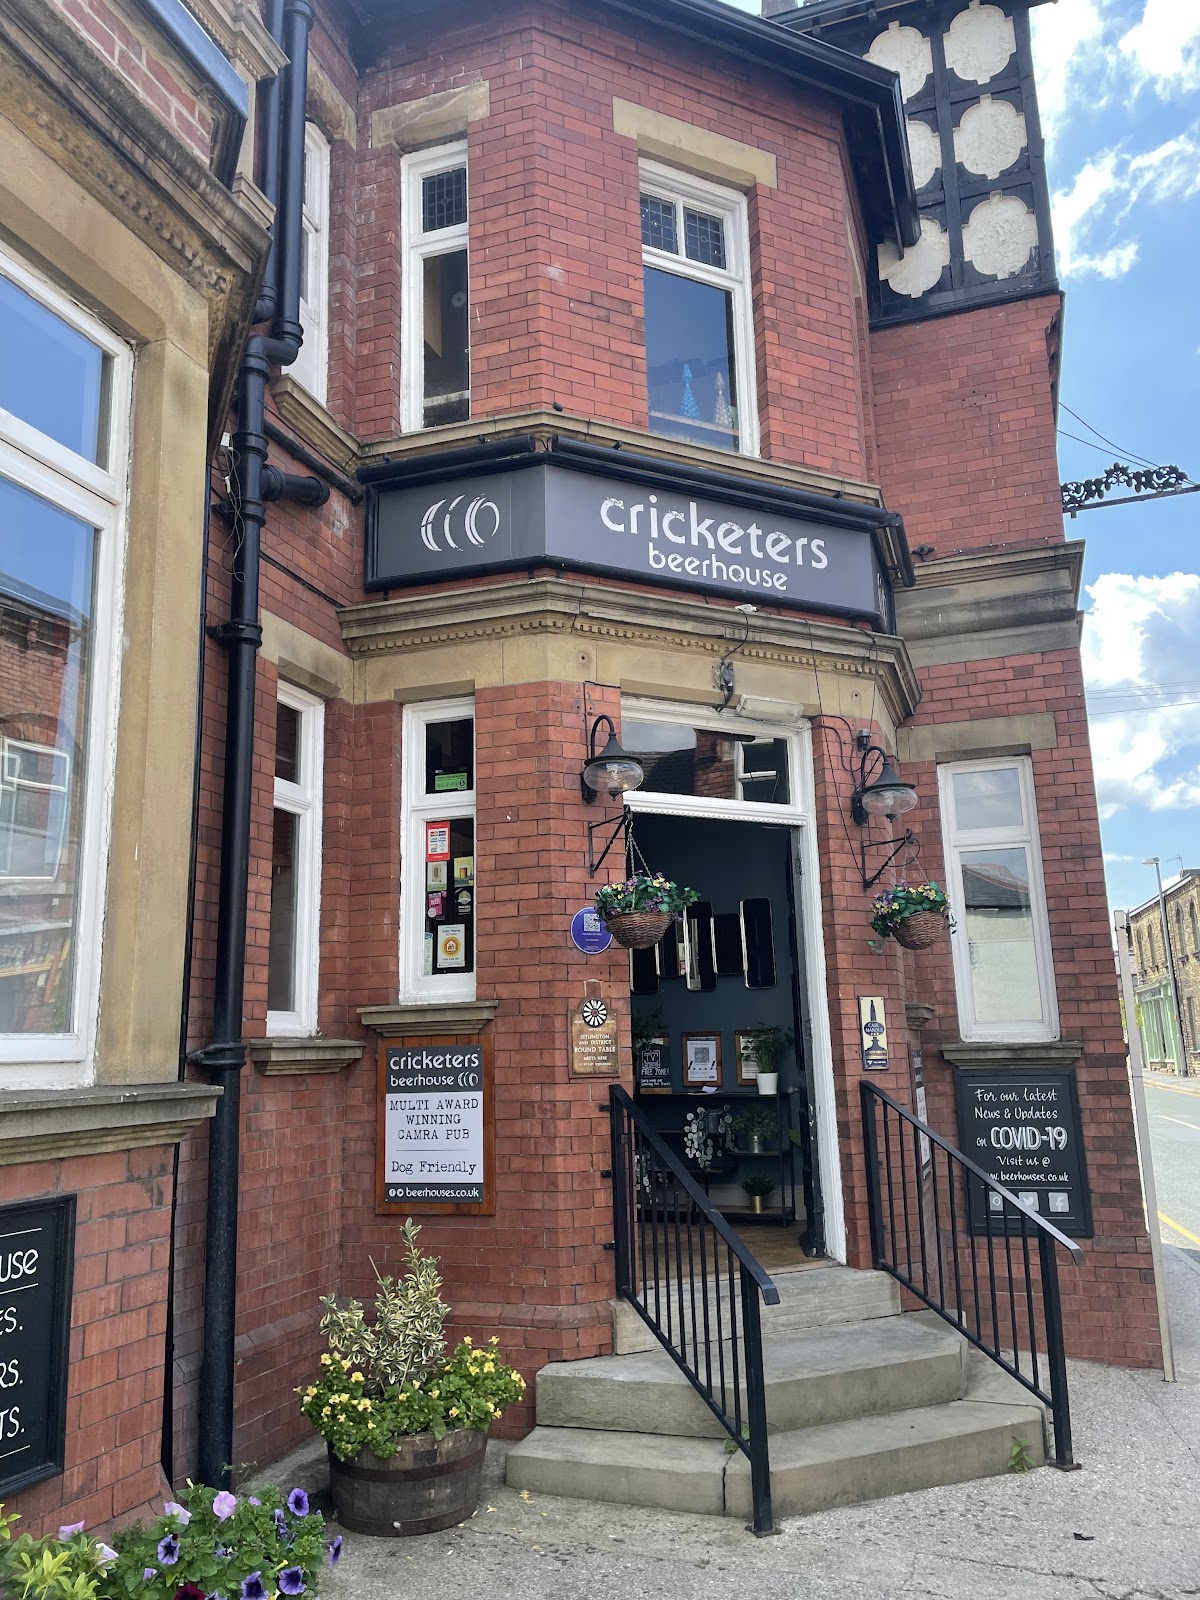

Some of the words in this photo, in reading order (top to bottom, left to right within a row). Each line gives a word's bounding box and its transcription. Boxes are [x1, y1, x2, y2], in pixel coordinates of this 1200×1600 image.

[600, 494, 828, 569] cricketers
[648, 541, 789, 590] beerhouse
[389, 1050, 479, 1070] cricketers
[390, 1075, 455, 1087] beerhouse
[975, 1088, 997, 1102] For
[1000, 1093, 1019, 1102] our
[1023, 1088, 1058, 1101] latest
[390, 1100, 430, 1111] MULTI
[437, 1099, 479, 1109] AWARD
[406, 1114, 461, 1125] WINNING
[974, 1107, 1000, 1119] News
[1004, 1108, 1011, 1119] &
[1015, 1106, 1058, 1120] Updates
[398, 1129, 439, 1140] CAMRA
[446, 1129, 470, 1139] PUB
[976, 1136, 988, 1147] on
[990, 1126, 1068, 1150] COVID-19
[392, 1161, 413, 1175] Dog
[419, 1161, 477, 1175] Friendly
[996, 1155, 1023, 1166] Visit
[1026, 1157, 1039, 1166] us
[1042, 1156, 1051, 1167] @
[406, 1187, 479, 1198] beerhouses.co.uk
